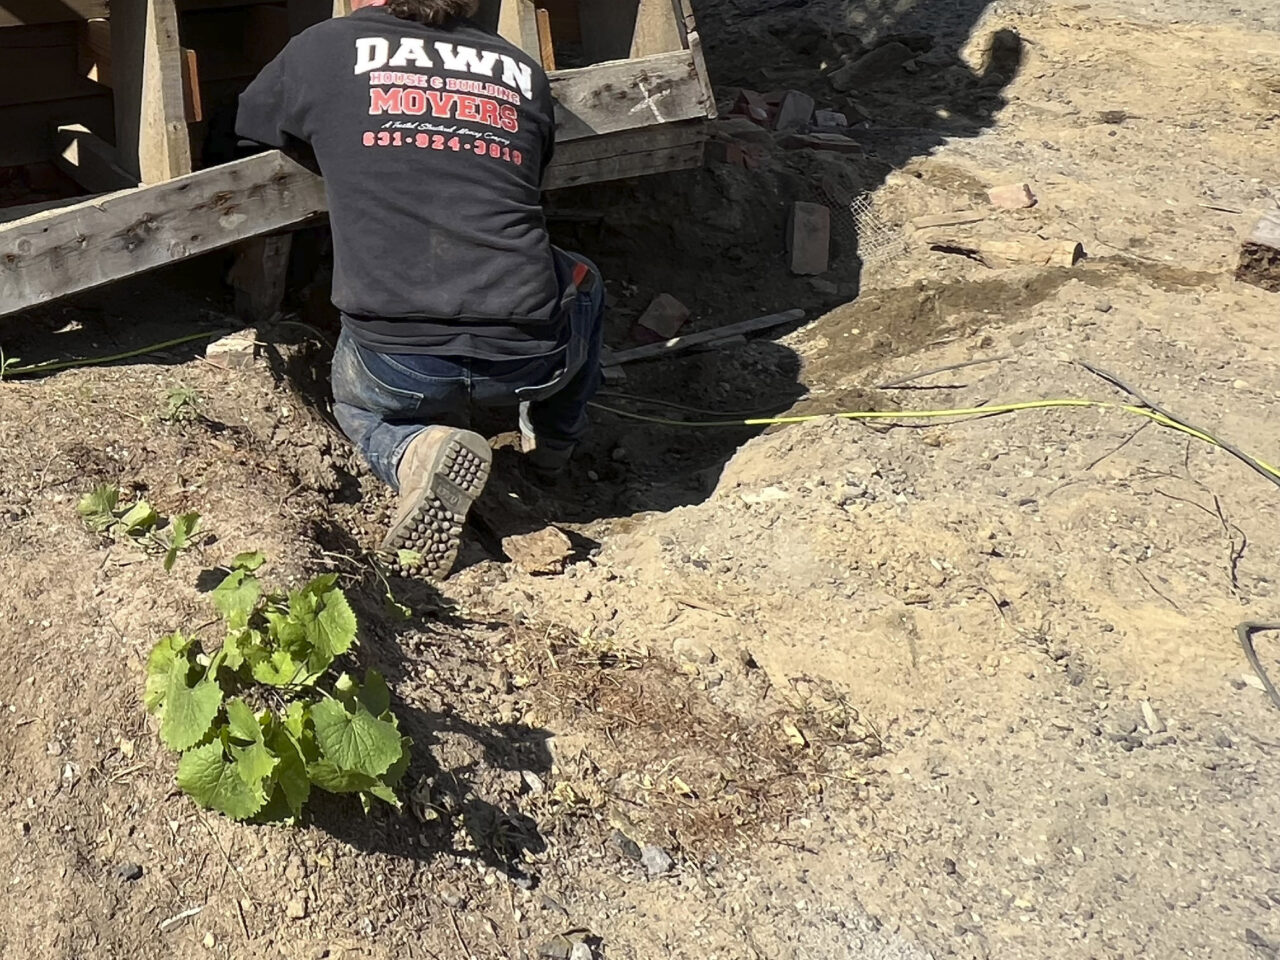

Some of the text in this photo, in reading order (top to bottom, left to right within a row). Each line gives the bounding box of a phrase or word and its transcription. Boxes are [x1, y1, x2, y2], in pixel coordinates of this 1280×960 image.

[354, 37, 532, 100] DAWN
[369, 71, 428, 88] HOUSE
[446, 77, 520, 106] BUILDING
[369, 87, 519, 133] MOVERS
